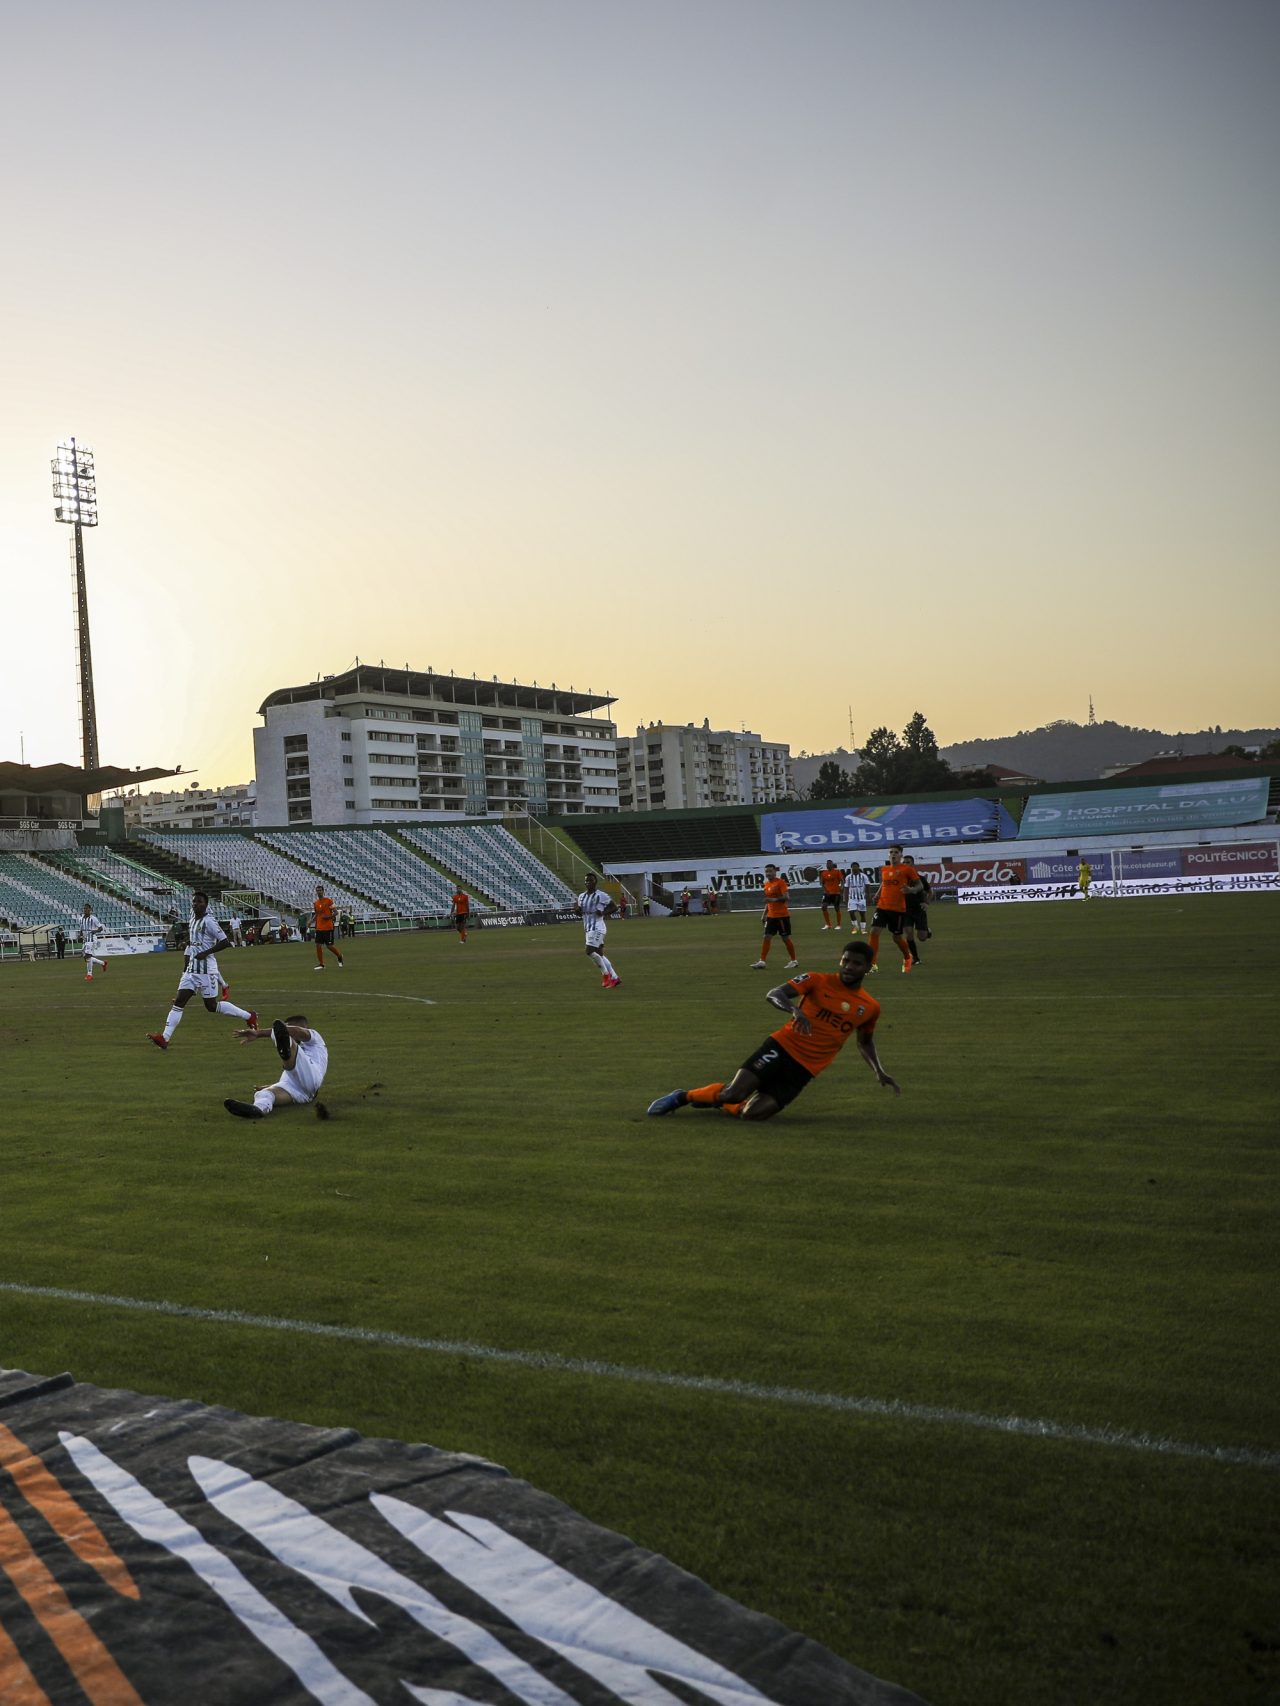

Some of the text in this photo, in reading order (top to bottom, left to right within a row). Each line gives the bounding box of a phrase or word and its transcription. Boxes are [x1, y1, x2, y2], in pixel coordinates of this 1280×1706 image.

[1068, 804, 1174, 815] HOSPITAL
[1179, 799, 1211, 809] DA
[775, 823, 985, 847] Robbialac
[1187, 850, 1268, 863] POLITÉCNICO
[816, 1008, 852, 1033] MEO
[762, 1049, 779, 1063] 2
